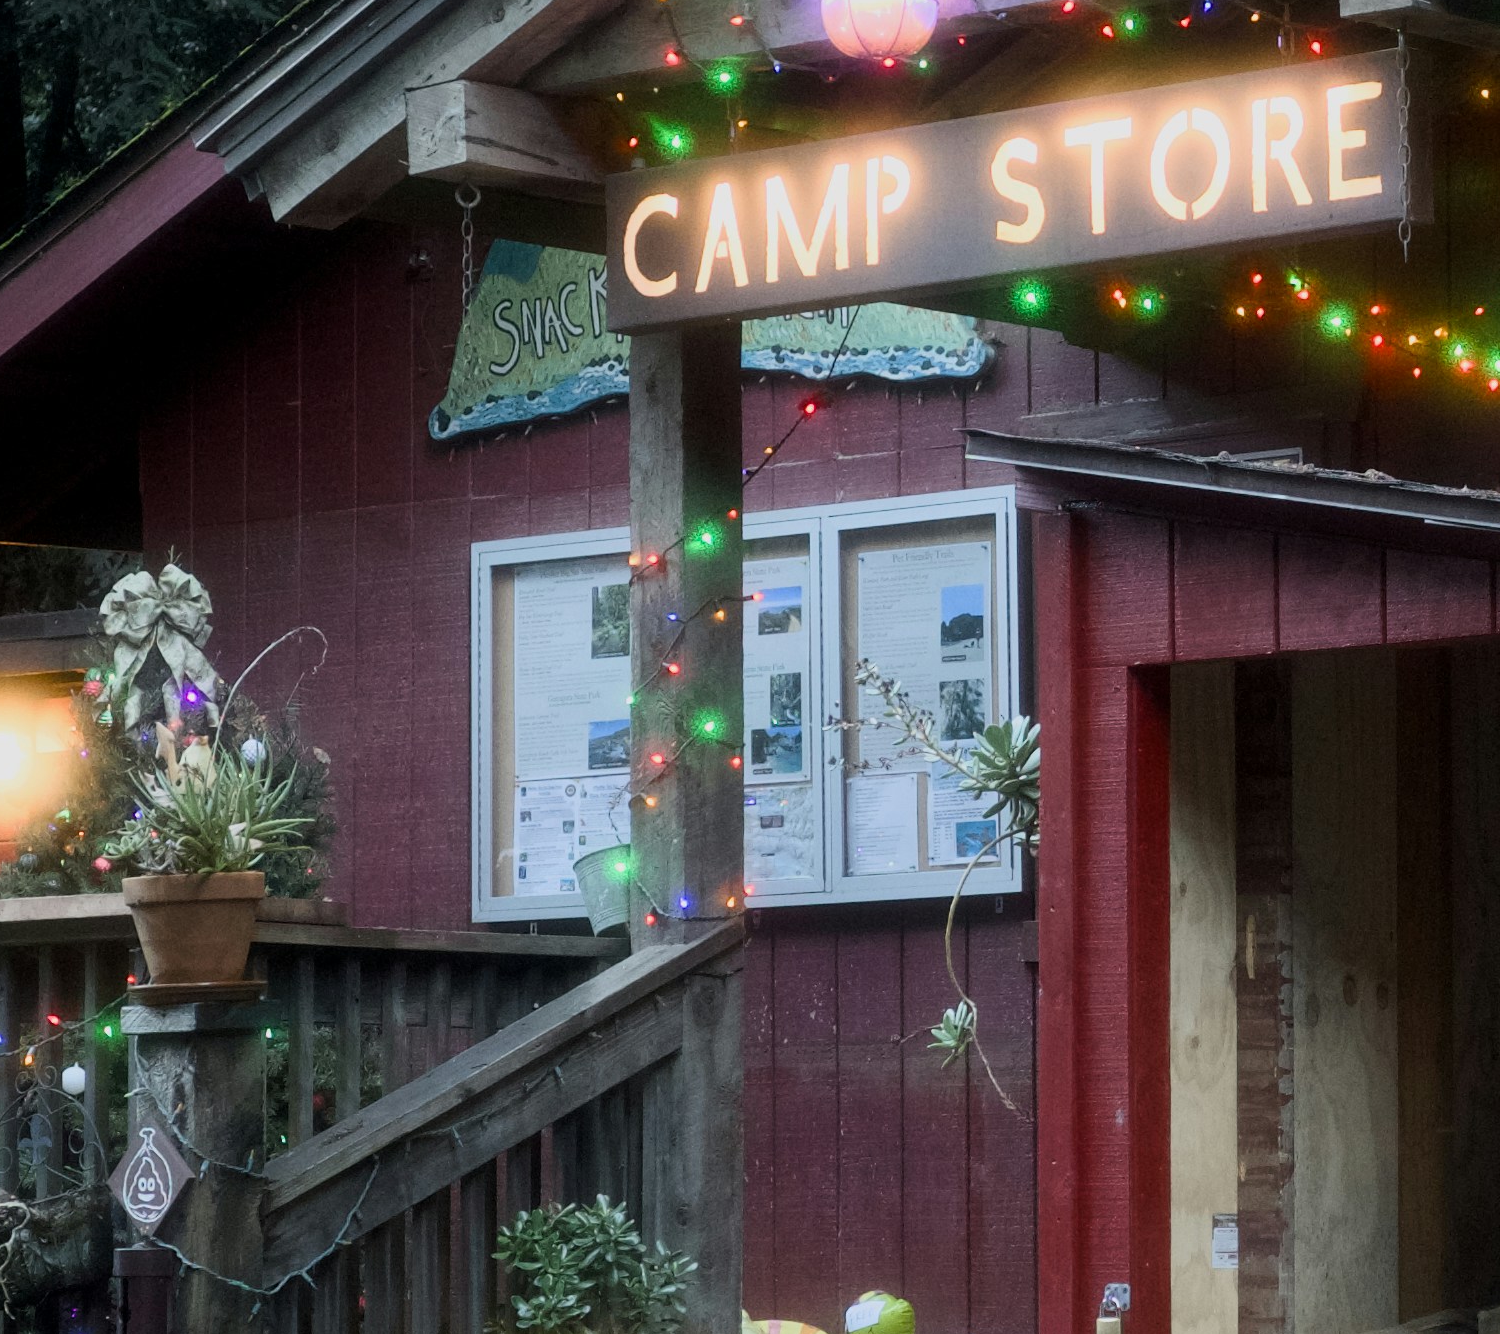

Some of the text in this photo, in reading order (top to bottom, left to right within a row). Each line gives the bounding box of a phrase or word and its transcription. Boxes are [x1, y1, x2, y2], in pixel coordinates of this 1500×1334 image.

[621, 80, 1384, 299] CAMP STORE
[489, 267, 607, 376] SNACK
